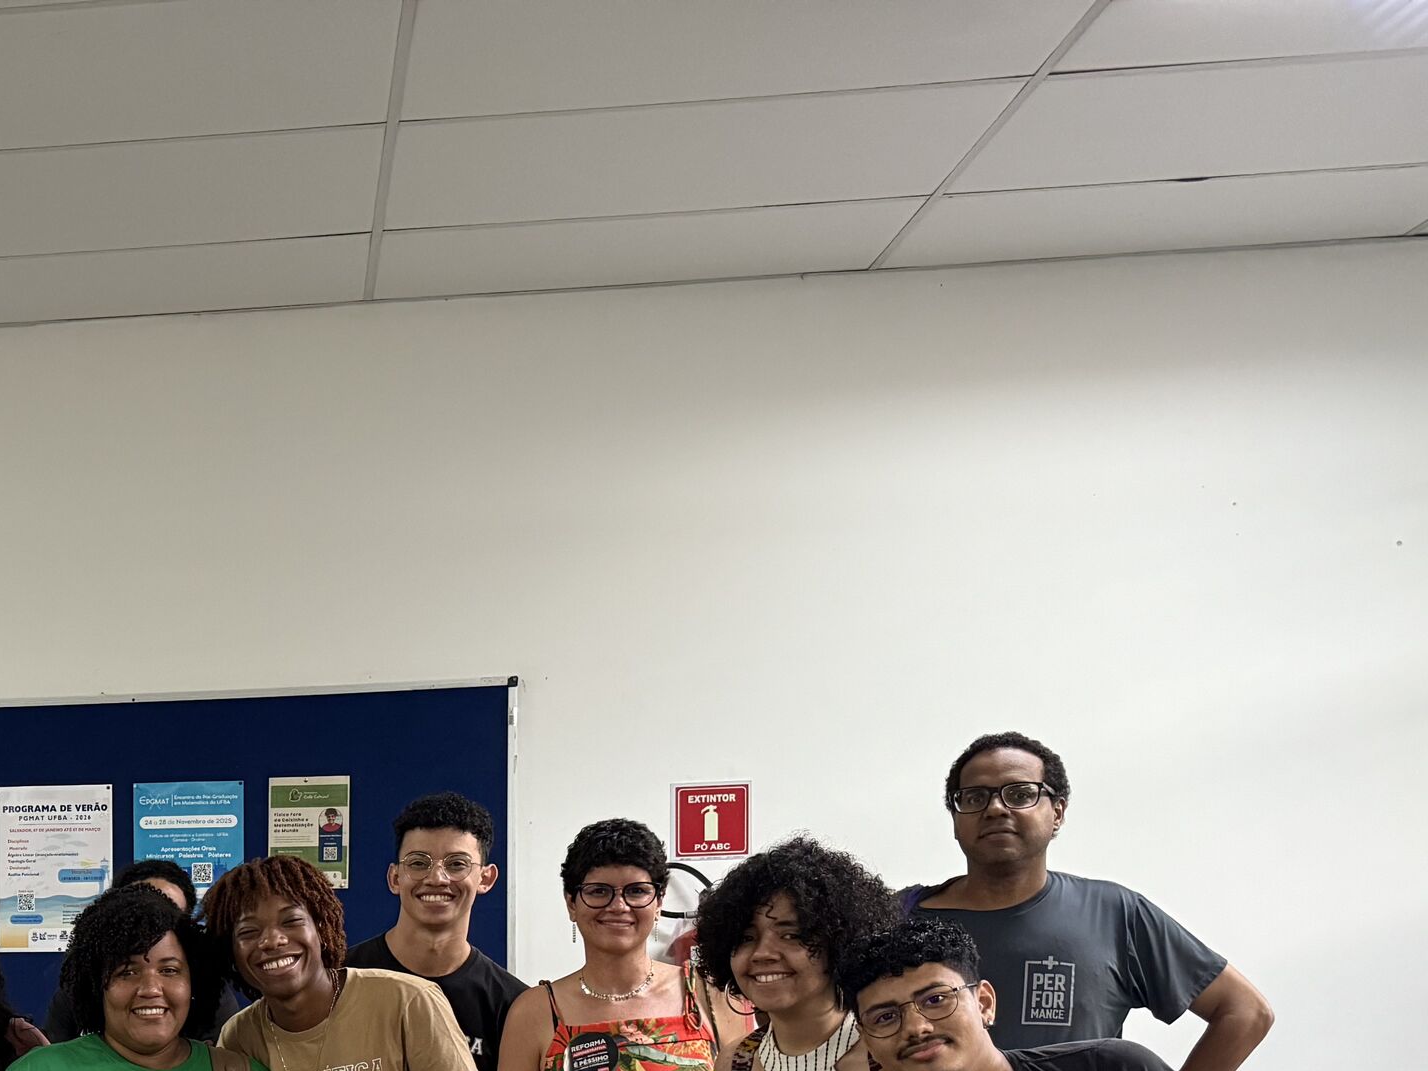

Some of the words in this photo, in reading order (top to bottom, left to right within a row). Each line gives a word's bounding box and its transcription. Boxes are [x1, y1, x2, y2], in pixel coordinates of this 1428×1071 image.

[687, 793, 736, 804] EXTINTOR
[2, 804, 57, 813] PROGRAMA
[60, 804, 72, 812] DE
[75, 802, 108, 812] VERÃO
[694, 842, 708, 851] PÓ
[710, 842, 731, 851] ABC
[1033, 973, 1066, 991] PER
[1032, 991, 1065, 1009] FOR
[1030, 1008, 1065, 1019] MANCE
[571, 1038, 606, 1053] REFORMA
[579, 1054, 609, 1067] PÉSSIMO
